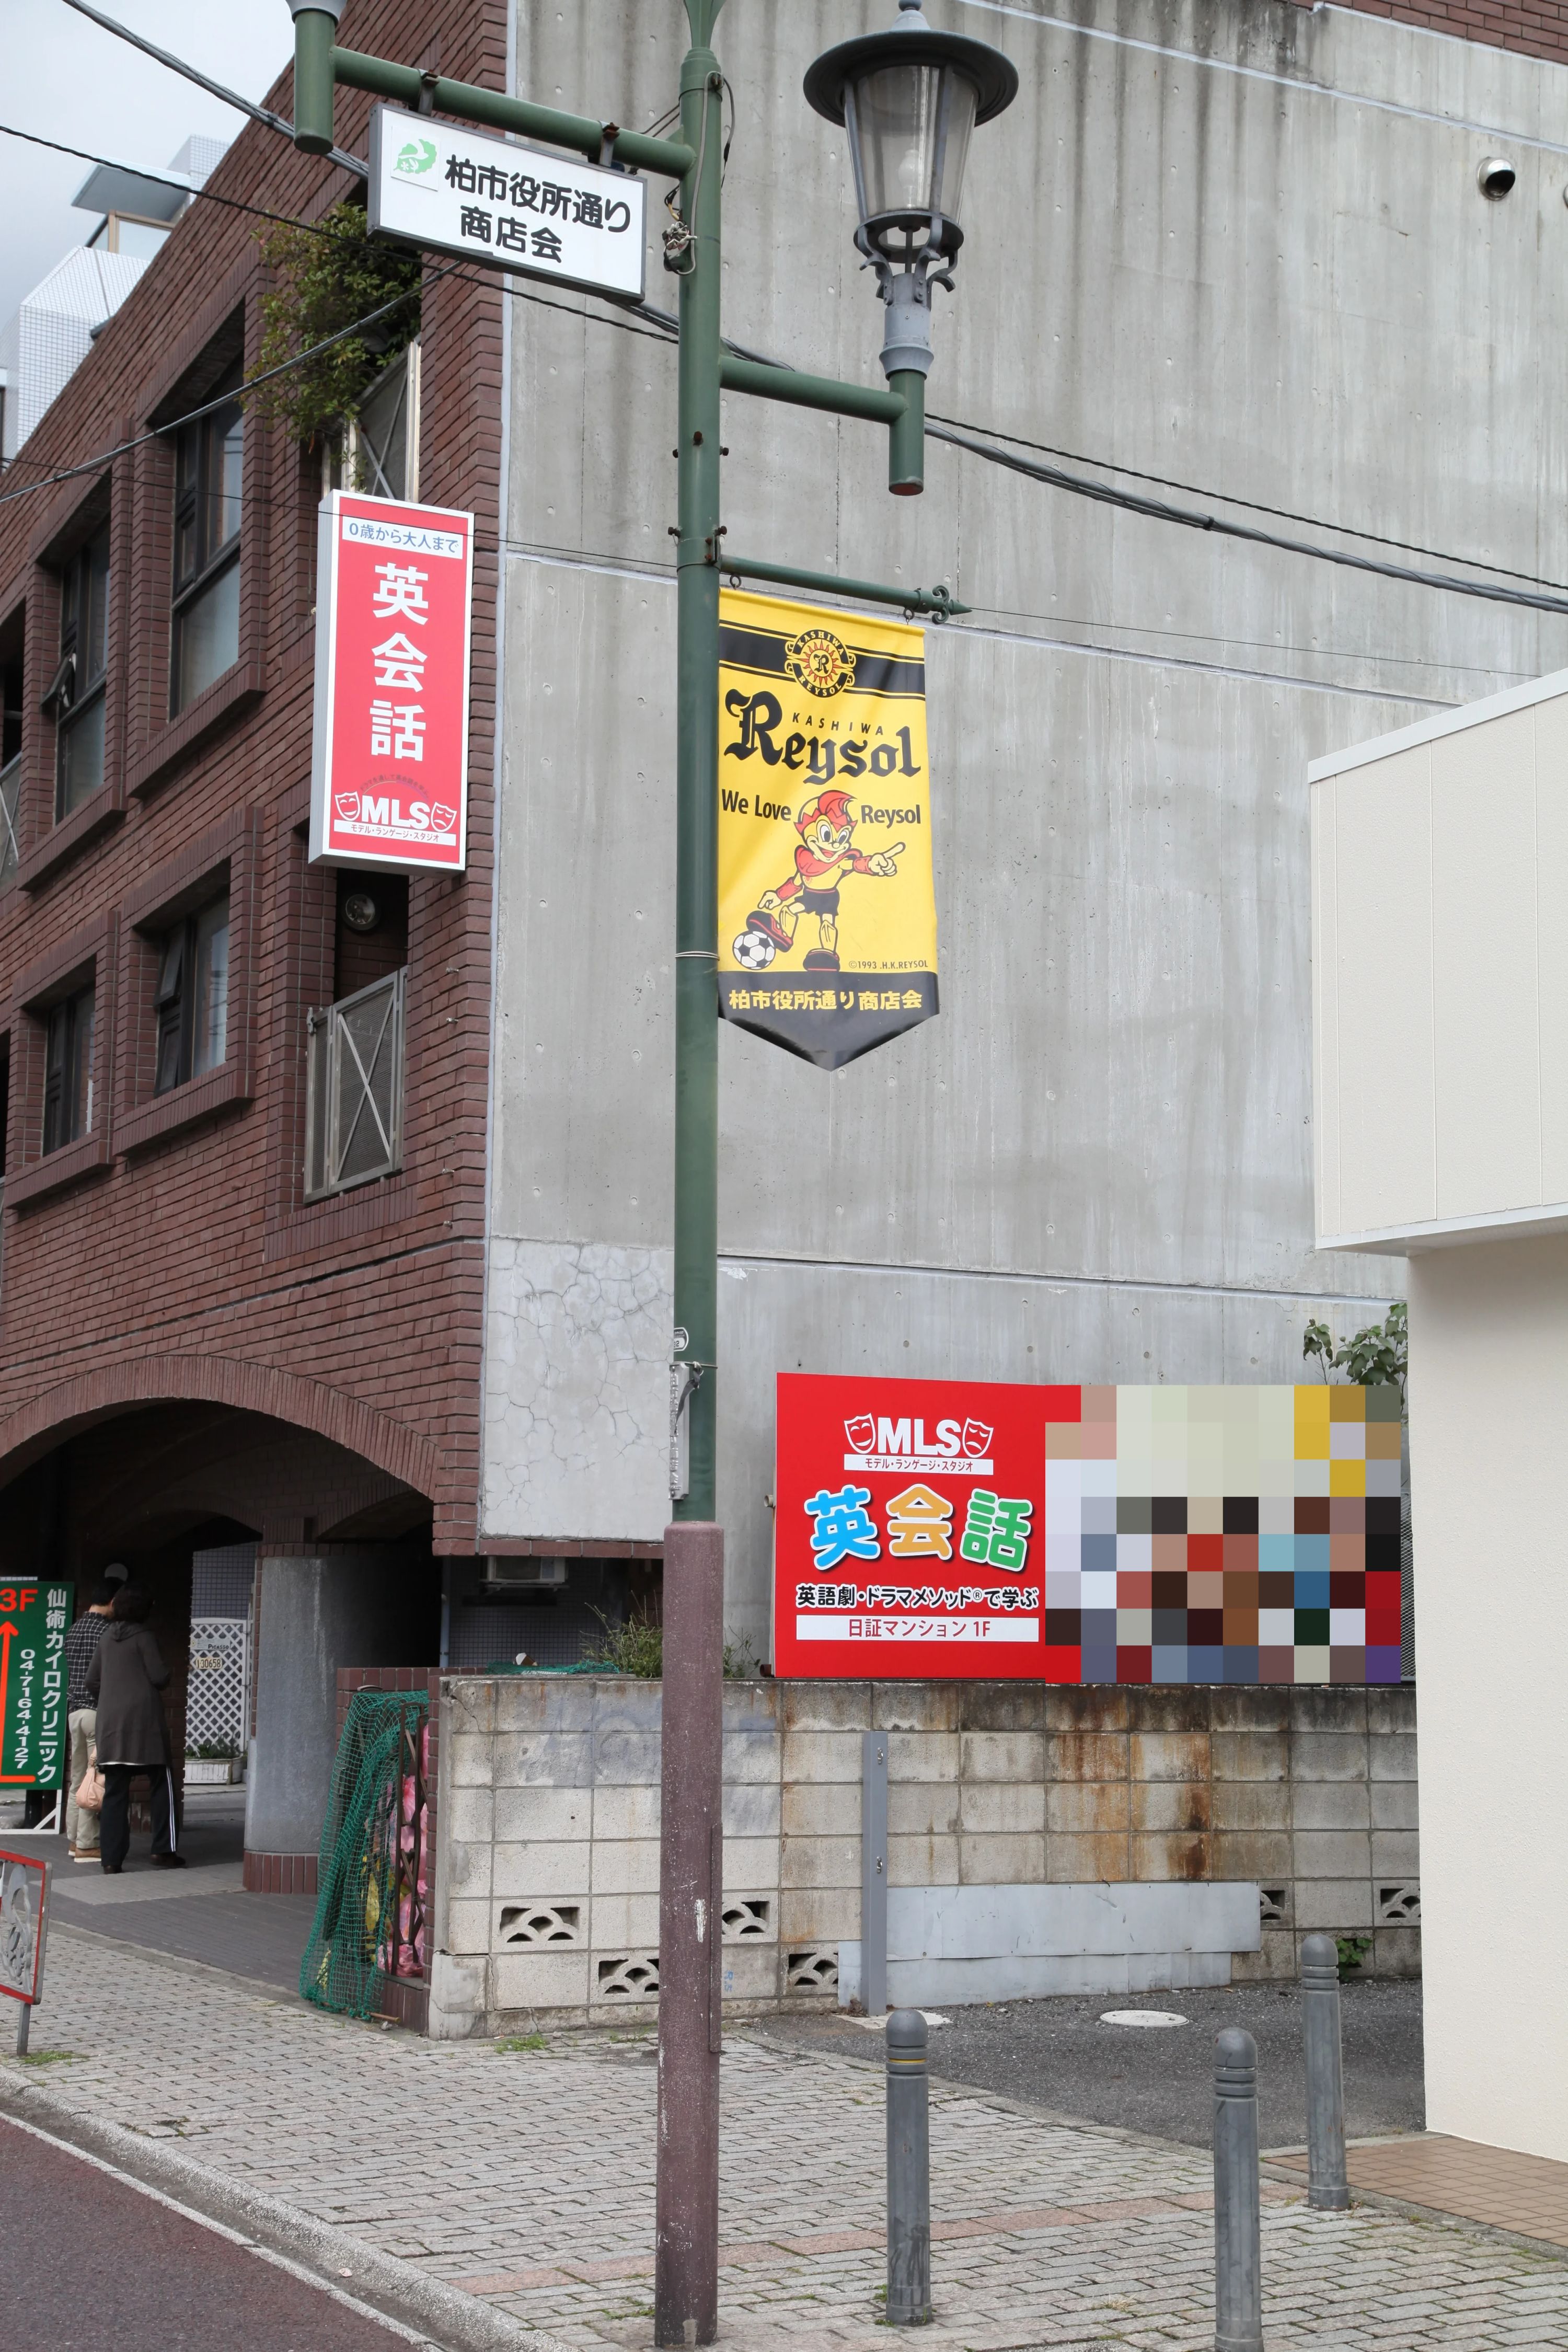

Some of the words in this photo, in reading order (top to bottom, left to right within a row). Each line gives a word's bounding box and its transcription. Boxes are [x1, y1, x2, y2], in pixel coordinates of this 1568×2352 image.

[444, 154, 631, 233] 柏市役所通り
[460, 205, 562, 263] 商店会
[349, 523, 459, 553] 0歳から大人まで
[797, 631, 844, 655] KASHIWA
[370, 562, 429, 762] 英会話
[813, 654, 829, 674] R
[799, 675, 841, 696] REYSOL
[724, 689, 921, 785] Reysol
[792, 712, 884, 735] KASHIWA
[361, 794, 431, 830] MLS
[721, 789, 749, 814] We
[755, 794, 791, 821] Love
[861, 804, 921, 829] Reysol
[351, 824, 440, 842] モデル・ランゲージ・スタジオ
[729, 989, 923, 1011] 柏市役所通り商店会
[878, 1417, 961, 1457] MLS
[865, 1458, 973, 1472] モデル・ランゲージ・スタジオ
[804, 1483, 1033, 1572] 英会話
[0, 1588, 39, 1612] 3F
[848, 1618, 967, 1638] 日証マンション
[973, 1620, 991, 1638] 1F
[37, 1588, 67, 1783] 仙術カイロクリニック
